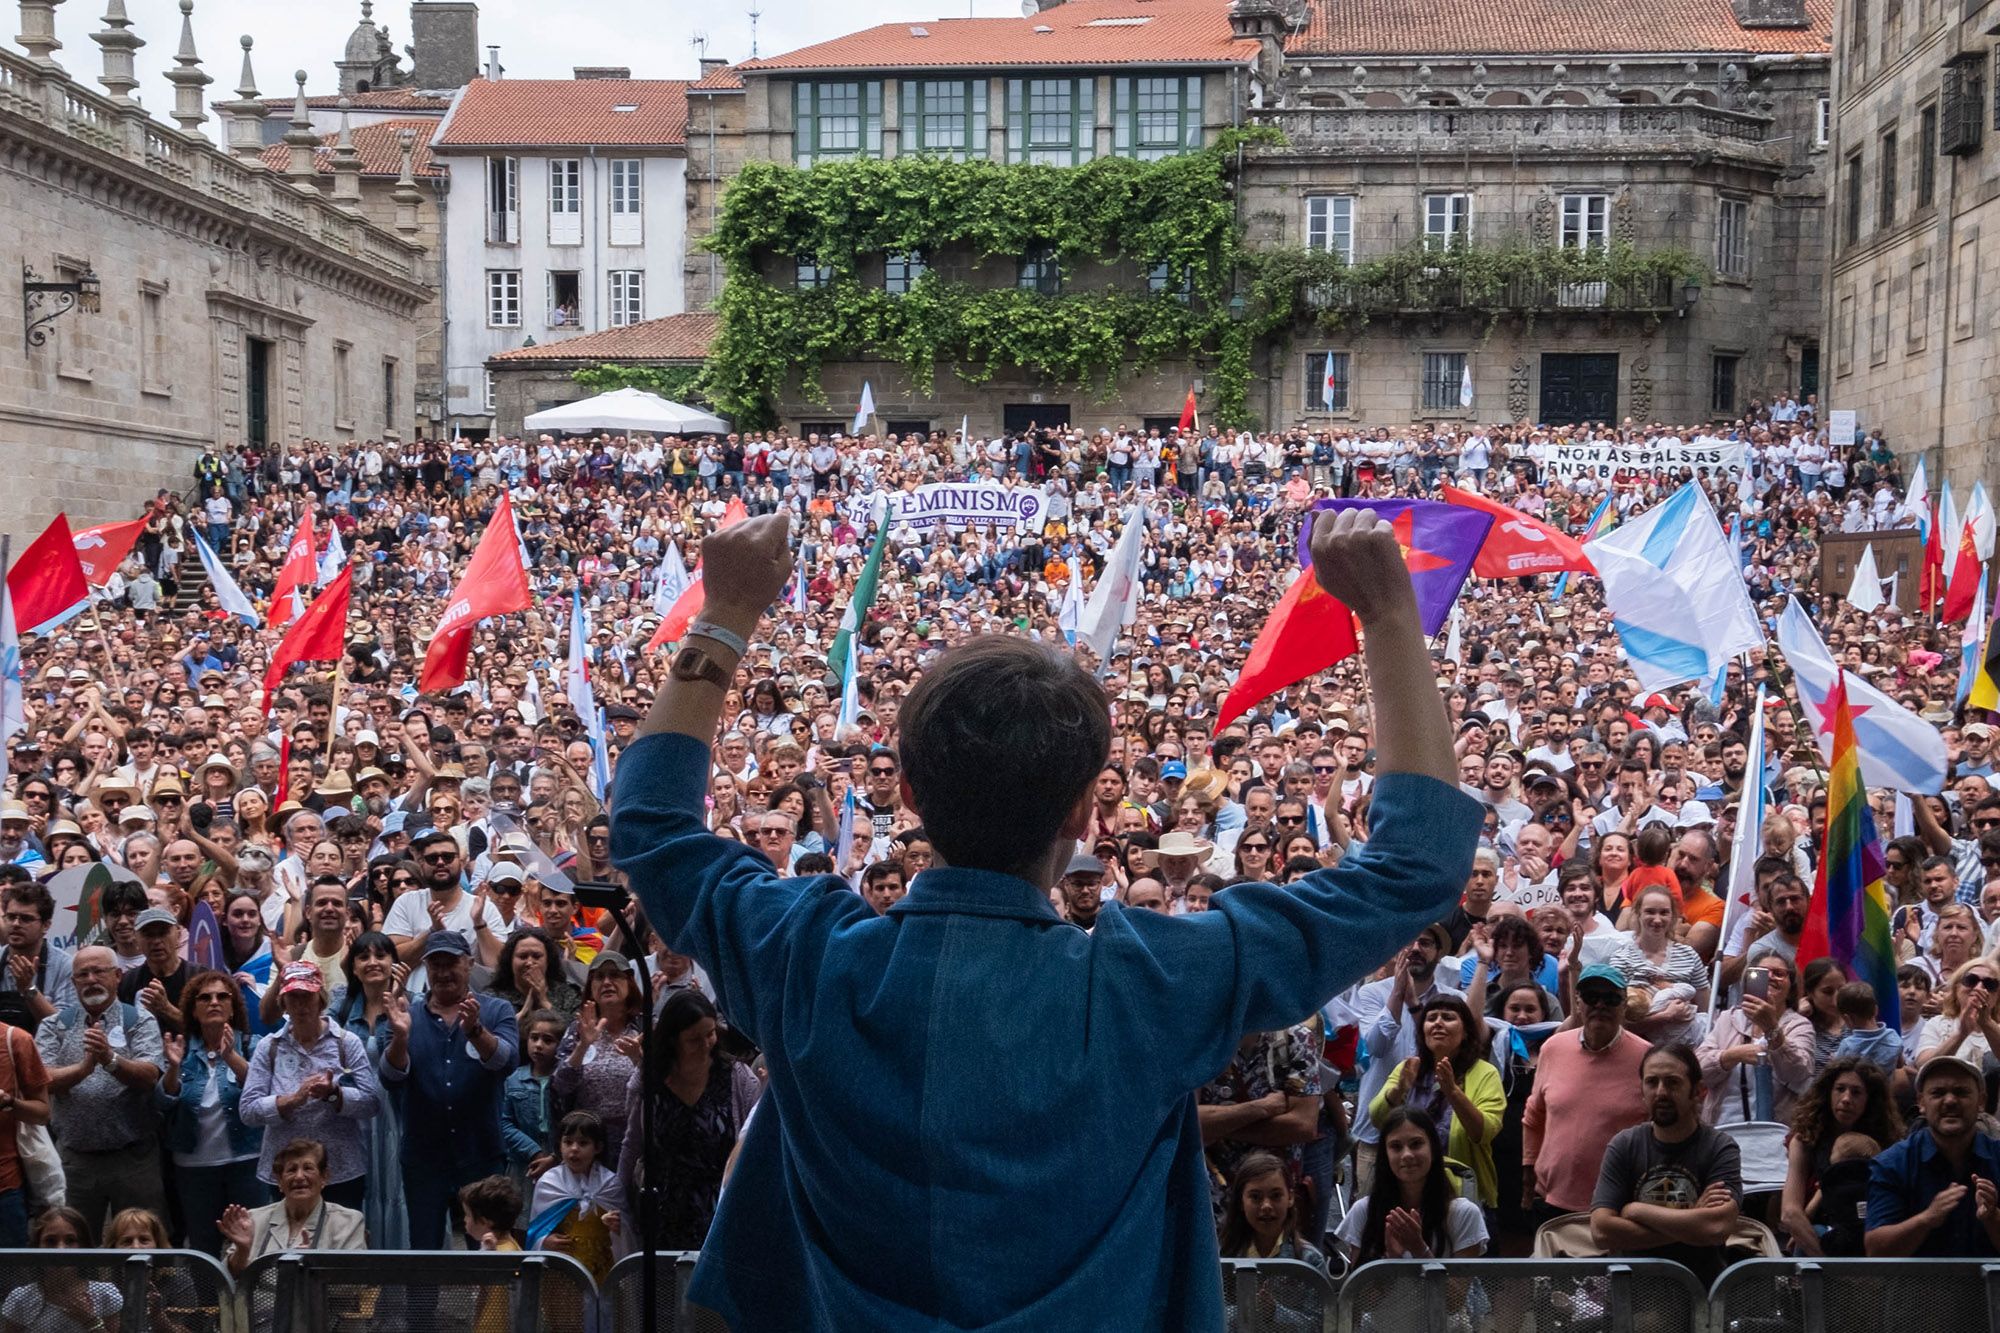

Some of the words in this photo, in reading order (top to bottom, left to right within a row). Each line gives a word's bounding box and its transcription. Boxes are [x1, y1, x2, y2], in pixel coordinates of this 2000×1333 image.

[1558, 446, 1600, 461] NON
[1606, 449, 1631, 463] AS
[1640, 449, 1721, 464] BALSAS
